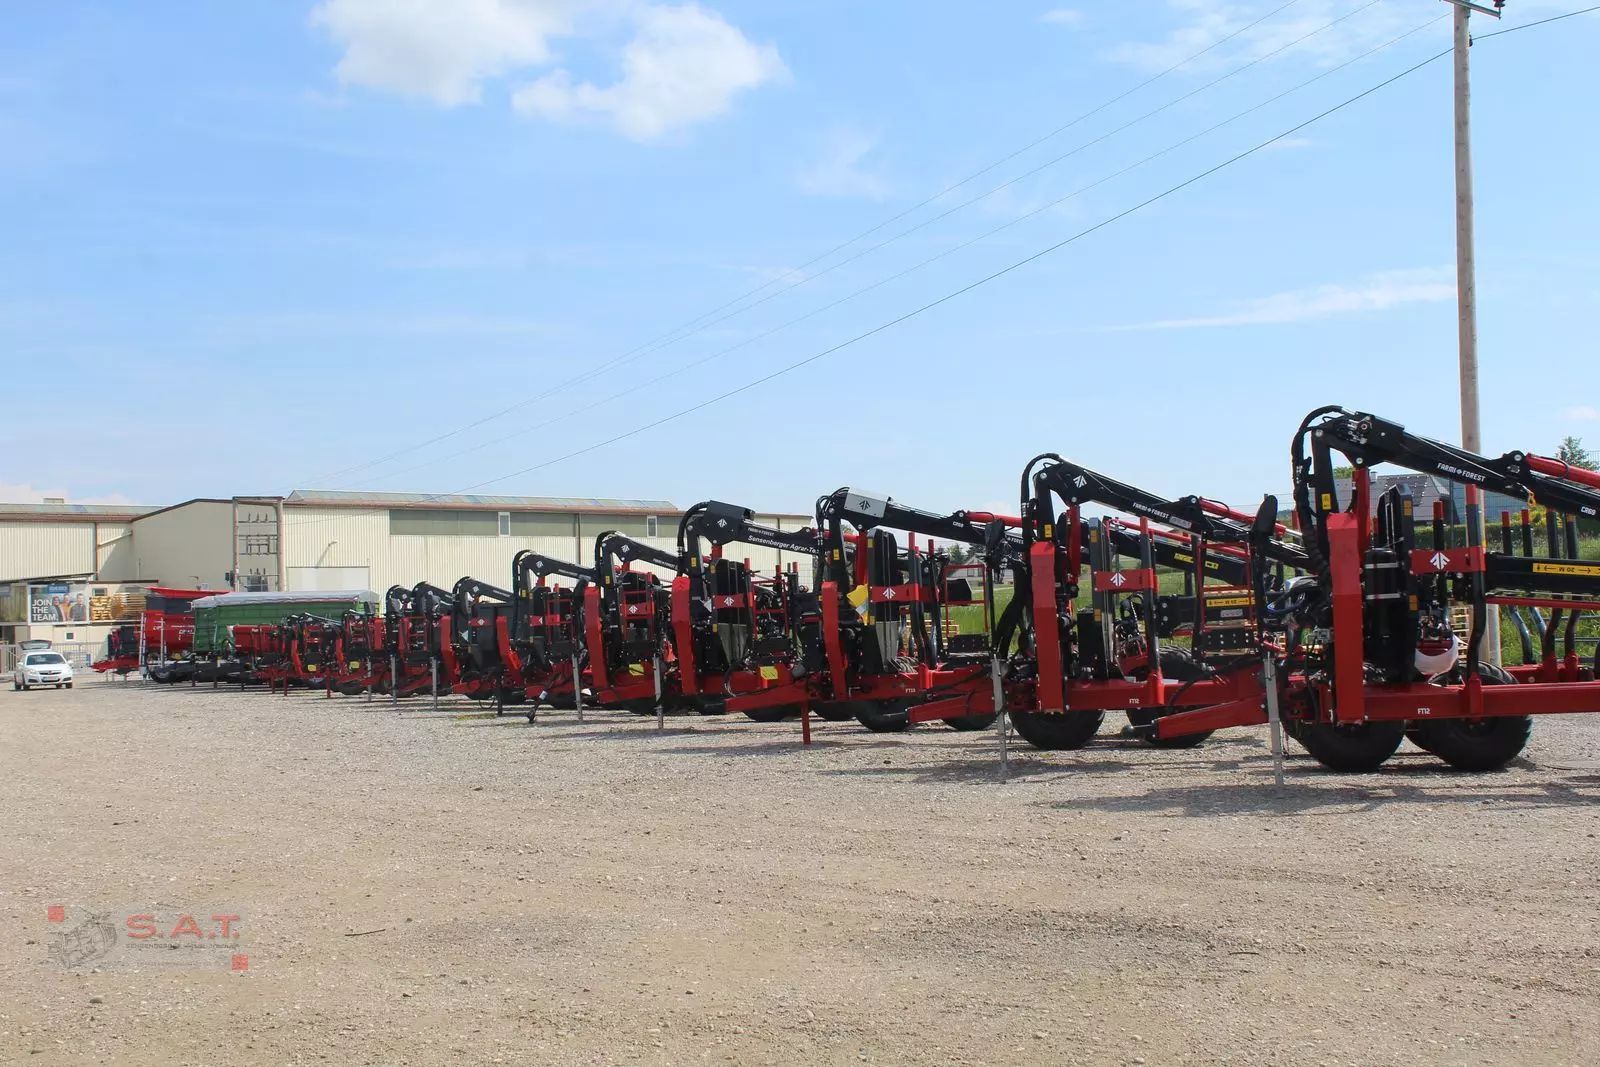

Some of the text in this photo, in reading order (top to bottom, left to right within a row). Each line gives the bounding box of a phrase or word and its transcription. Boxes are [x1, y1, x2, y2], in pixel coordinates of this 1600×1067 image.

[1437, 463, 1486, 482] FARMI FOREST
[1151, 508, 1169, 519] FOREST
[747, 535, 790, 549] Sensenberger
[32, 606, 48, 614] THE
[1417, 707, 1430, 715] FT12
